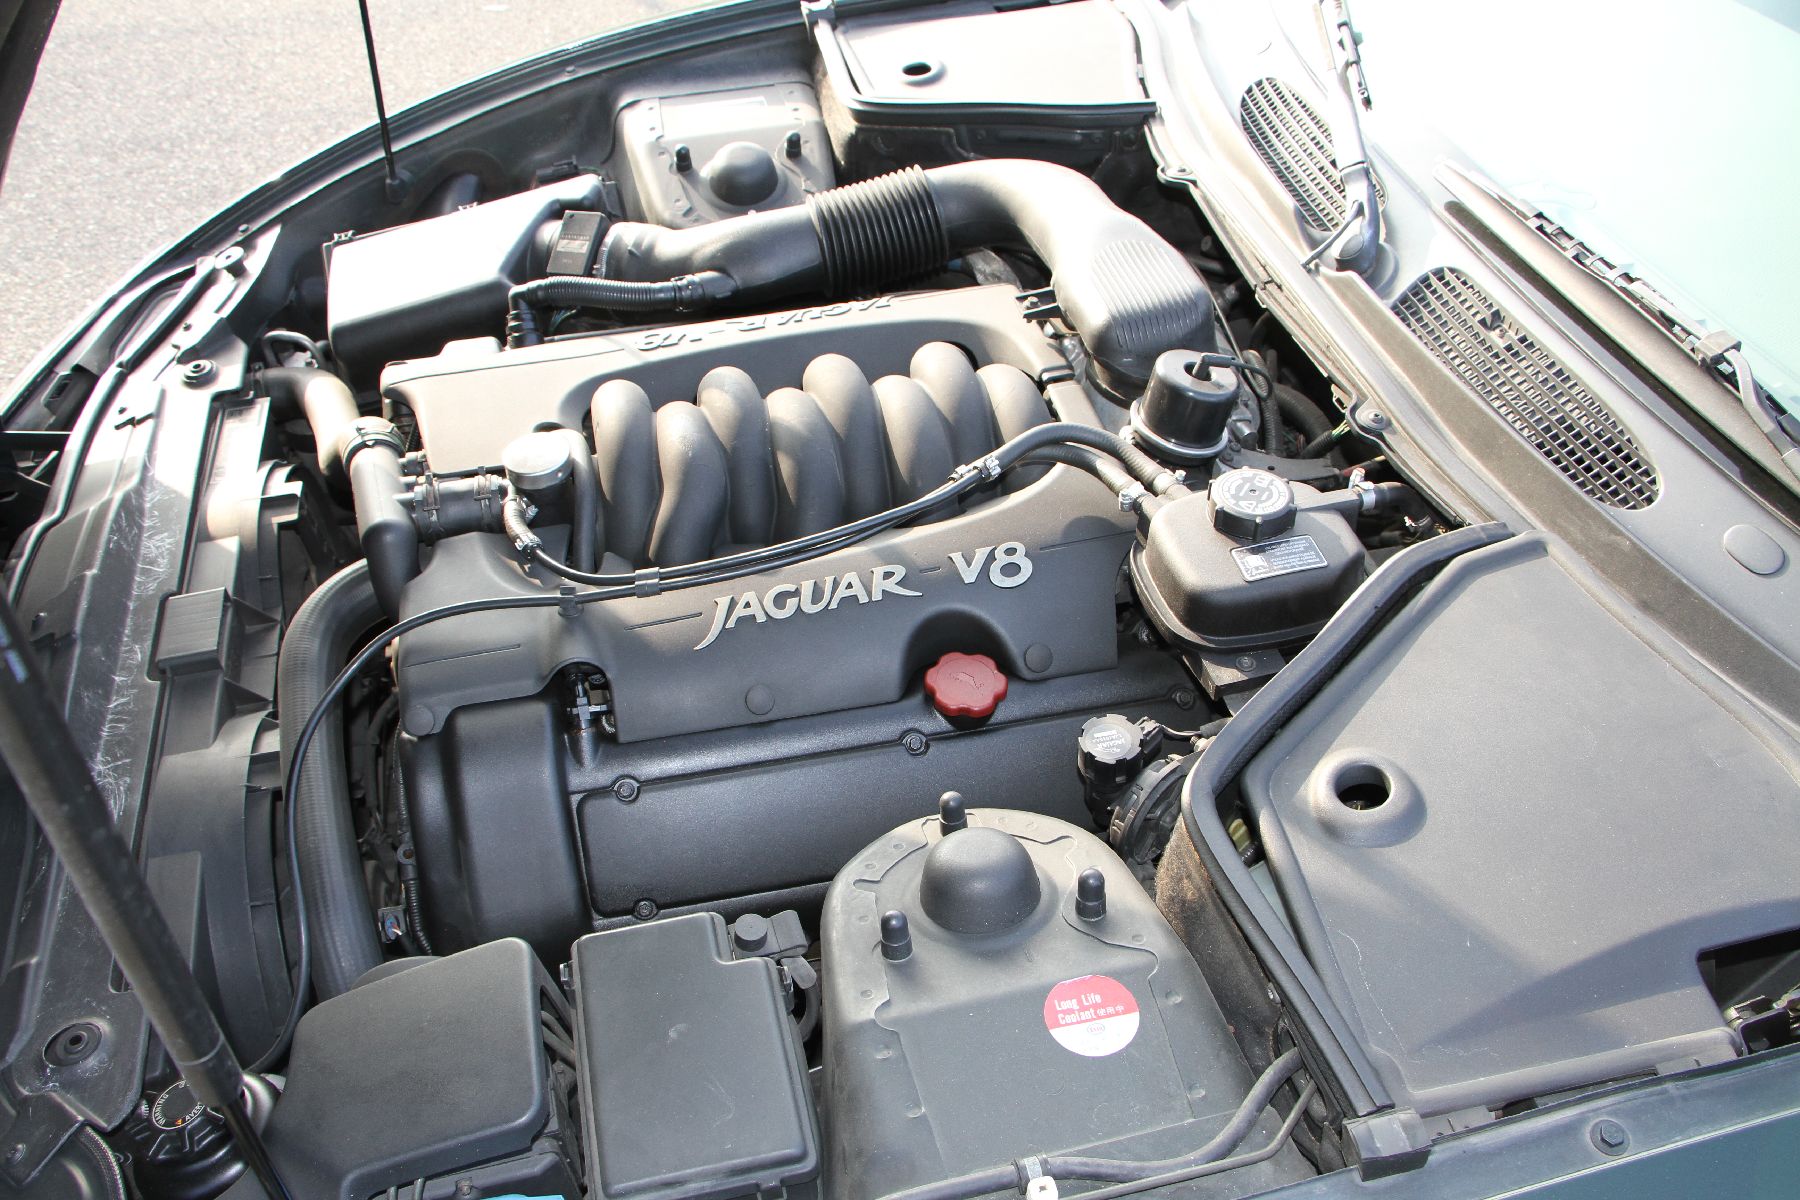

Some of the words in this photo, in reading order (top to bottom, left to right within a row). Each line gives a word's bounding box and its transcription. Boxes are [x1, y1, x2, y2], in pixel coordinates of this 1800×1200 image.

[694, 564, 923, 650] JAGUAR
[949, 541, 1033, 589] V8
[1055, 998, 1079, 1010] Long
[1081, 993, 1102, 1005] Life
[1058, 1008, 1096, 1024] Coolant
[154, 1094, 169, 1126] WARNING
